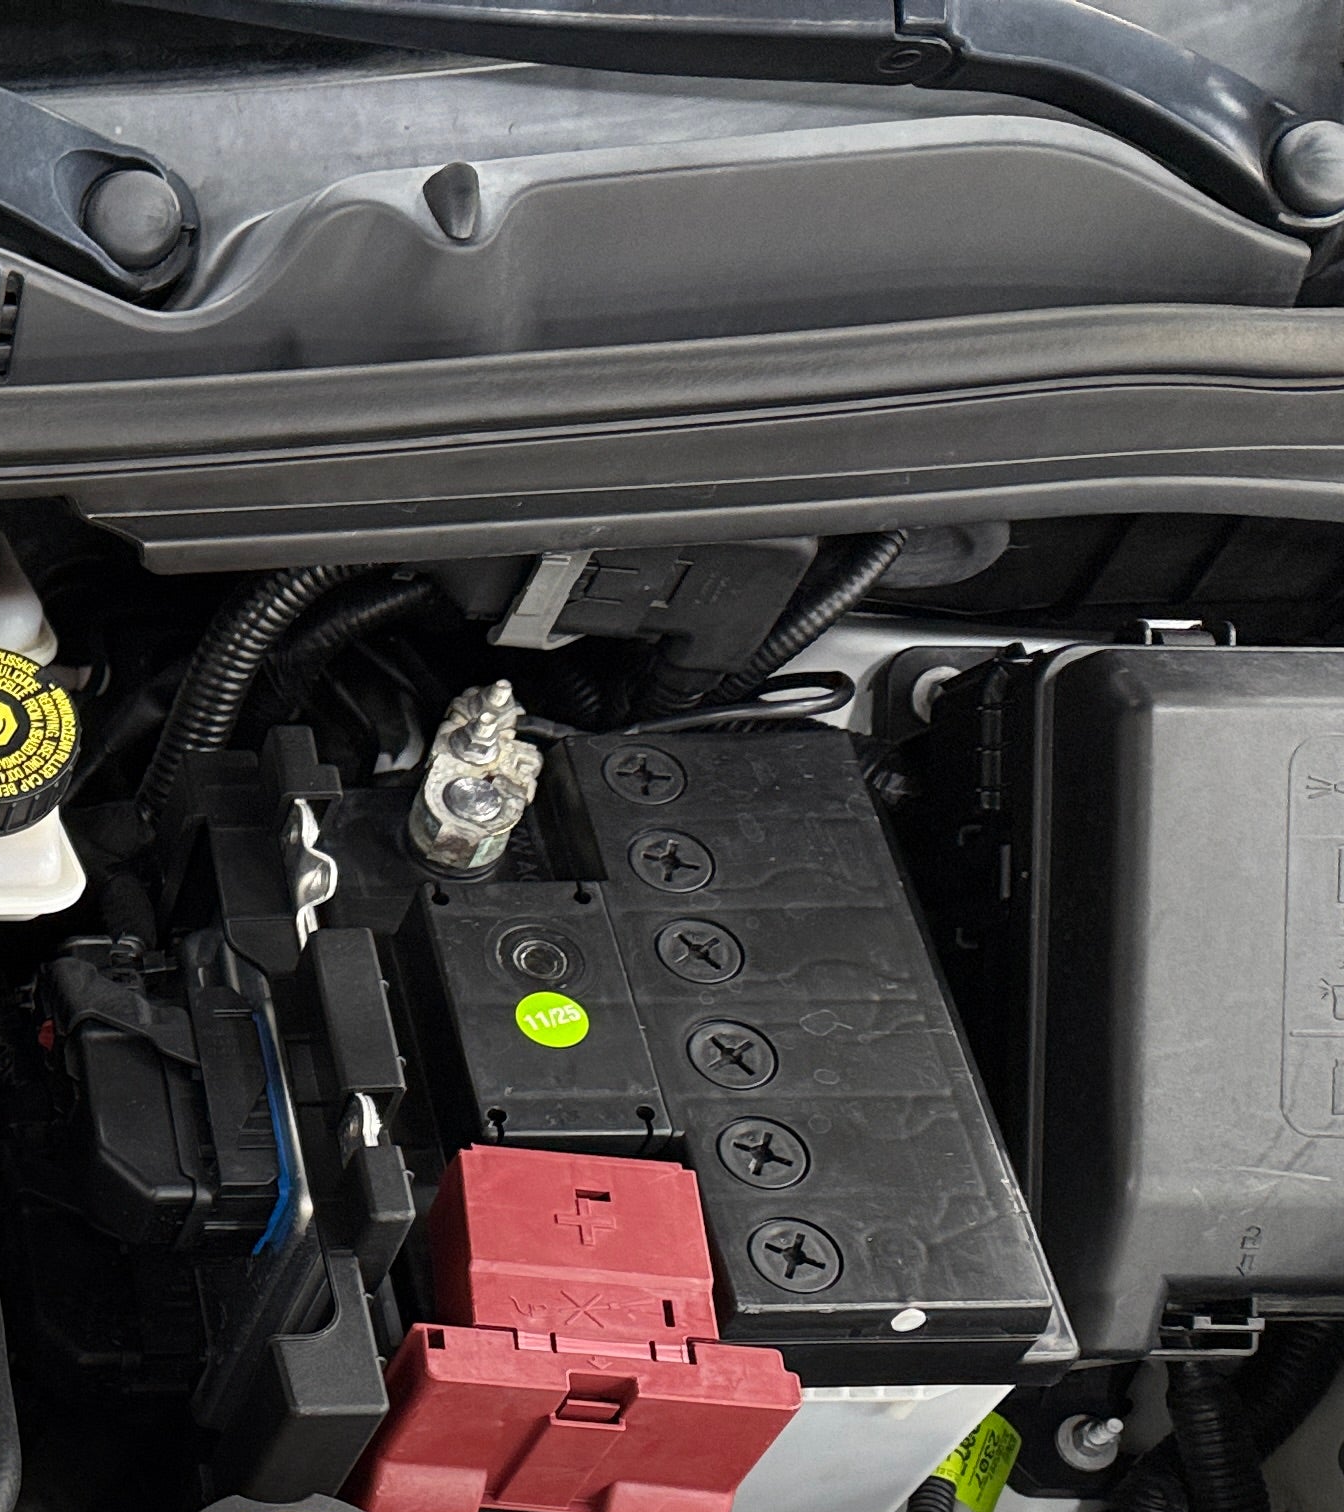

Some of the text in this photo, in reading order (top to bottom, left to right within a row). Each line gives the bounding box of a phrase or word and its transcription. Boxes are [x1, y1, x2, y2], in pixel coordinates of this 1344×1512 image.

[37, 741, 57, 758] USE
[22, 756, 45, 774] ONLY
[20, 775, 43, 793] CAP
[523, 1004, 581, 1031] 11/25
